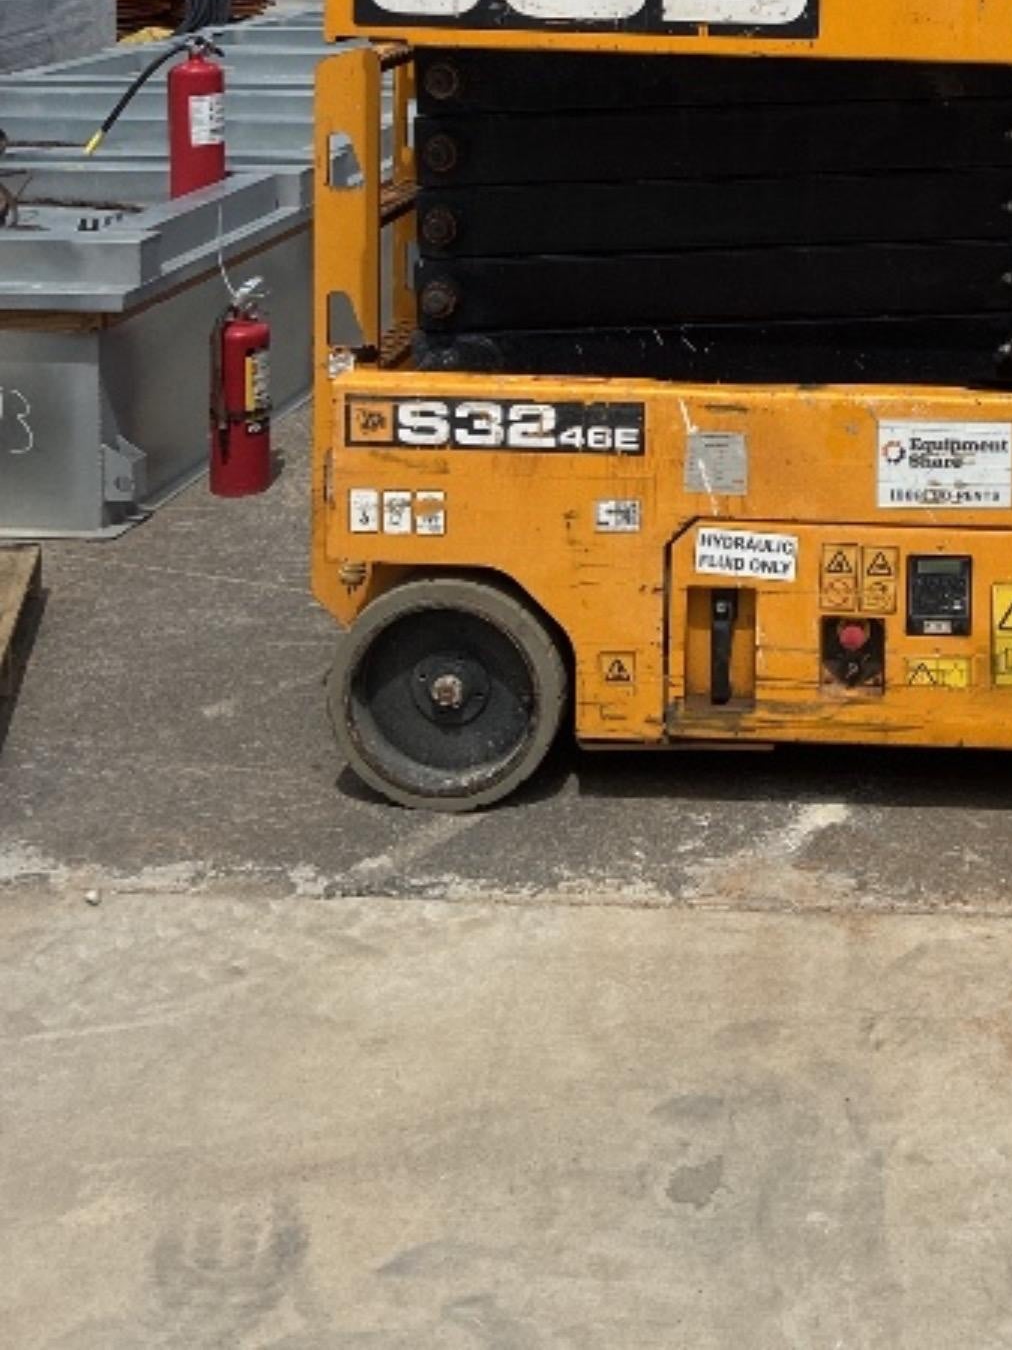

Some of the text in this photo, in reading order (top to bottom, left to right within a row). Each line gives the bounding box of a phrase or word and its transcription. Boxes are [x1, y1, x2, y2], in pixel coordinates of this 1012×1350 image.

[909, 437, 1009, 456] Equipment
[908, 453, 965, 468] Share
[700, 533, 794, 554] HYDRAULIC
[699, 554, 791, 574] FLUID ONLY
